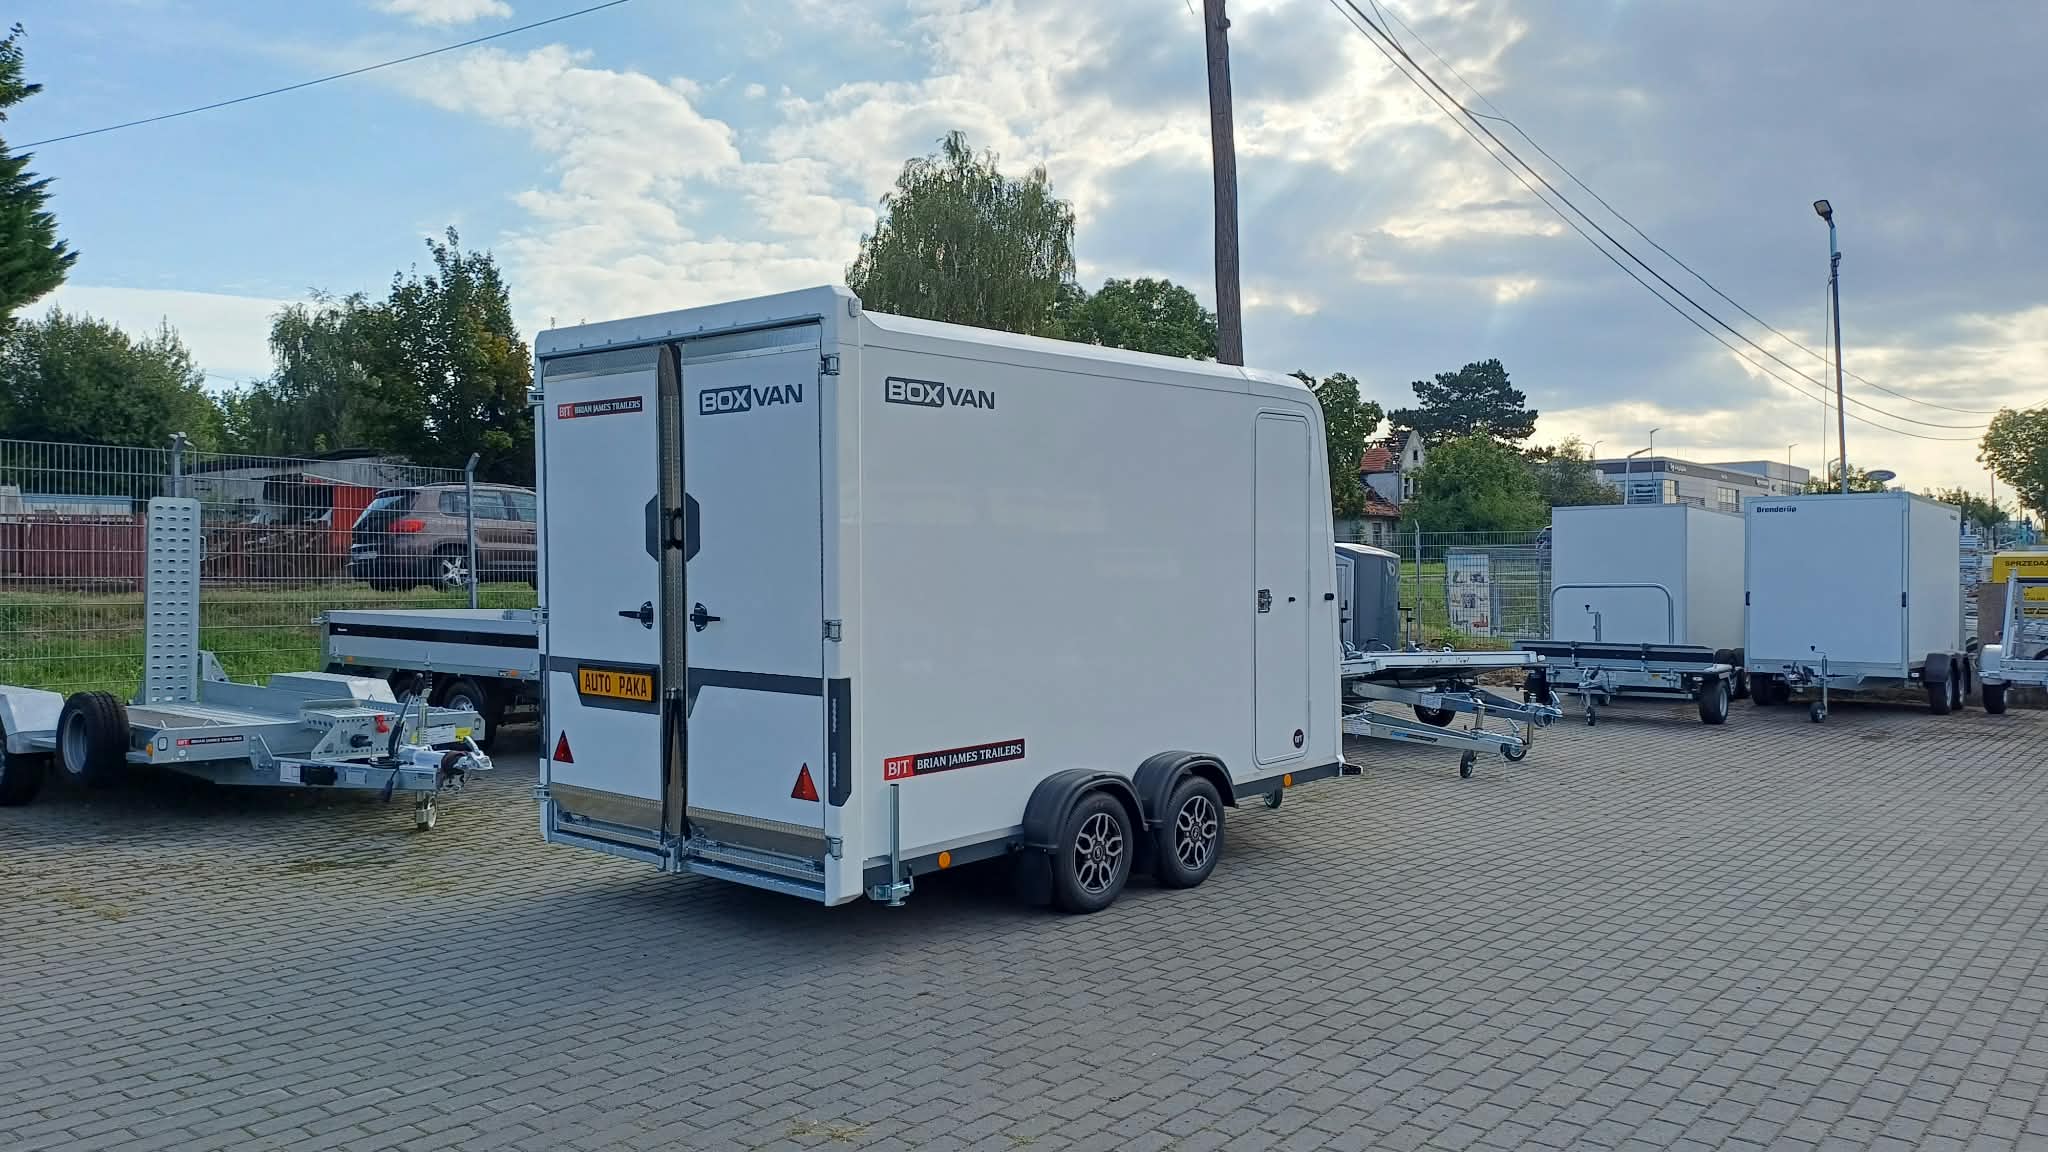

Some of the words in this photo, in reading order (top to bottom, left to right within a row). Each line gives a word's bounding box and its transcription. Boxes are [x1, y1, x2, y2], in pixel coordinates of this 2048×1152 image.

[593, 403, 611, 413] JAMES
[612, 400, 641, 411] TRAILERS
[584, 672, 611, 693] AUTO
[619, 675, 647, 697] PAKA
[917, 755, 947, 770] BRIAN
[948, 750, 978, 767] JAMES
[980, 743, 1022, 760] TRAILERS
